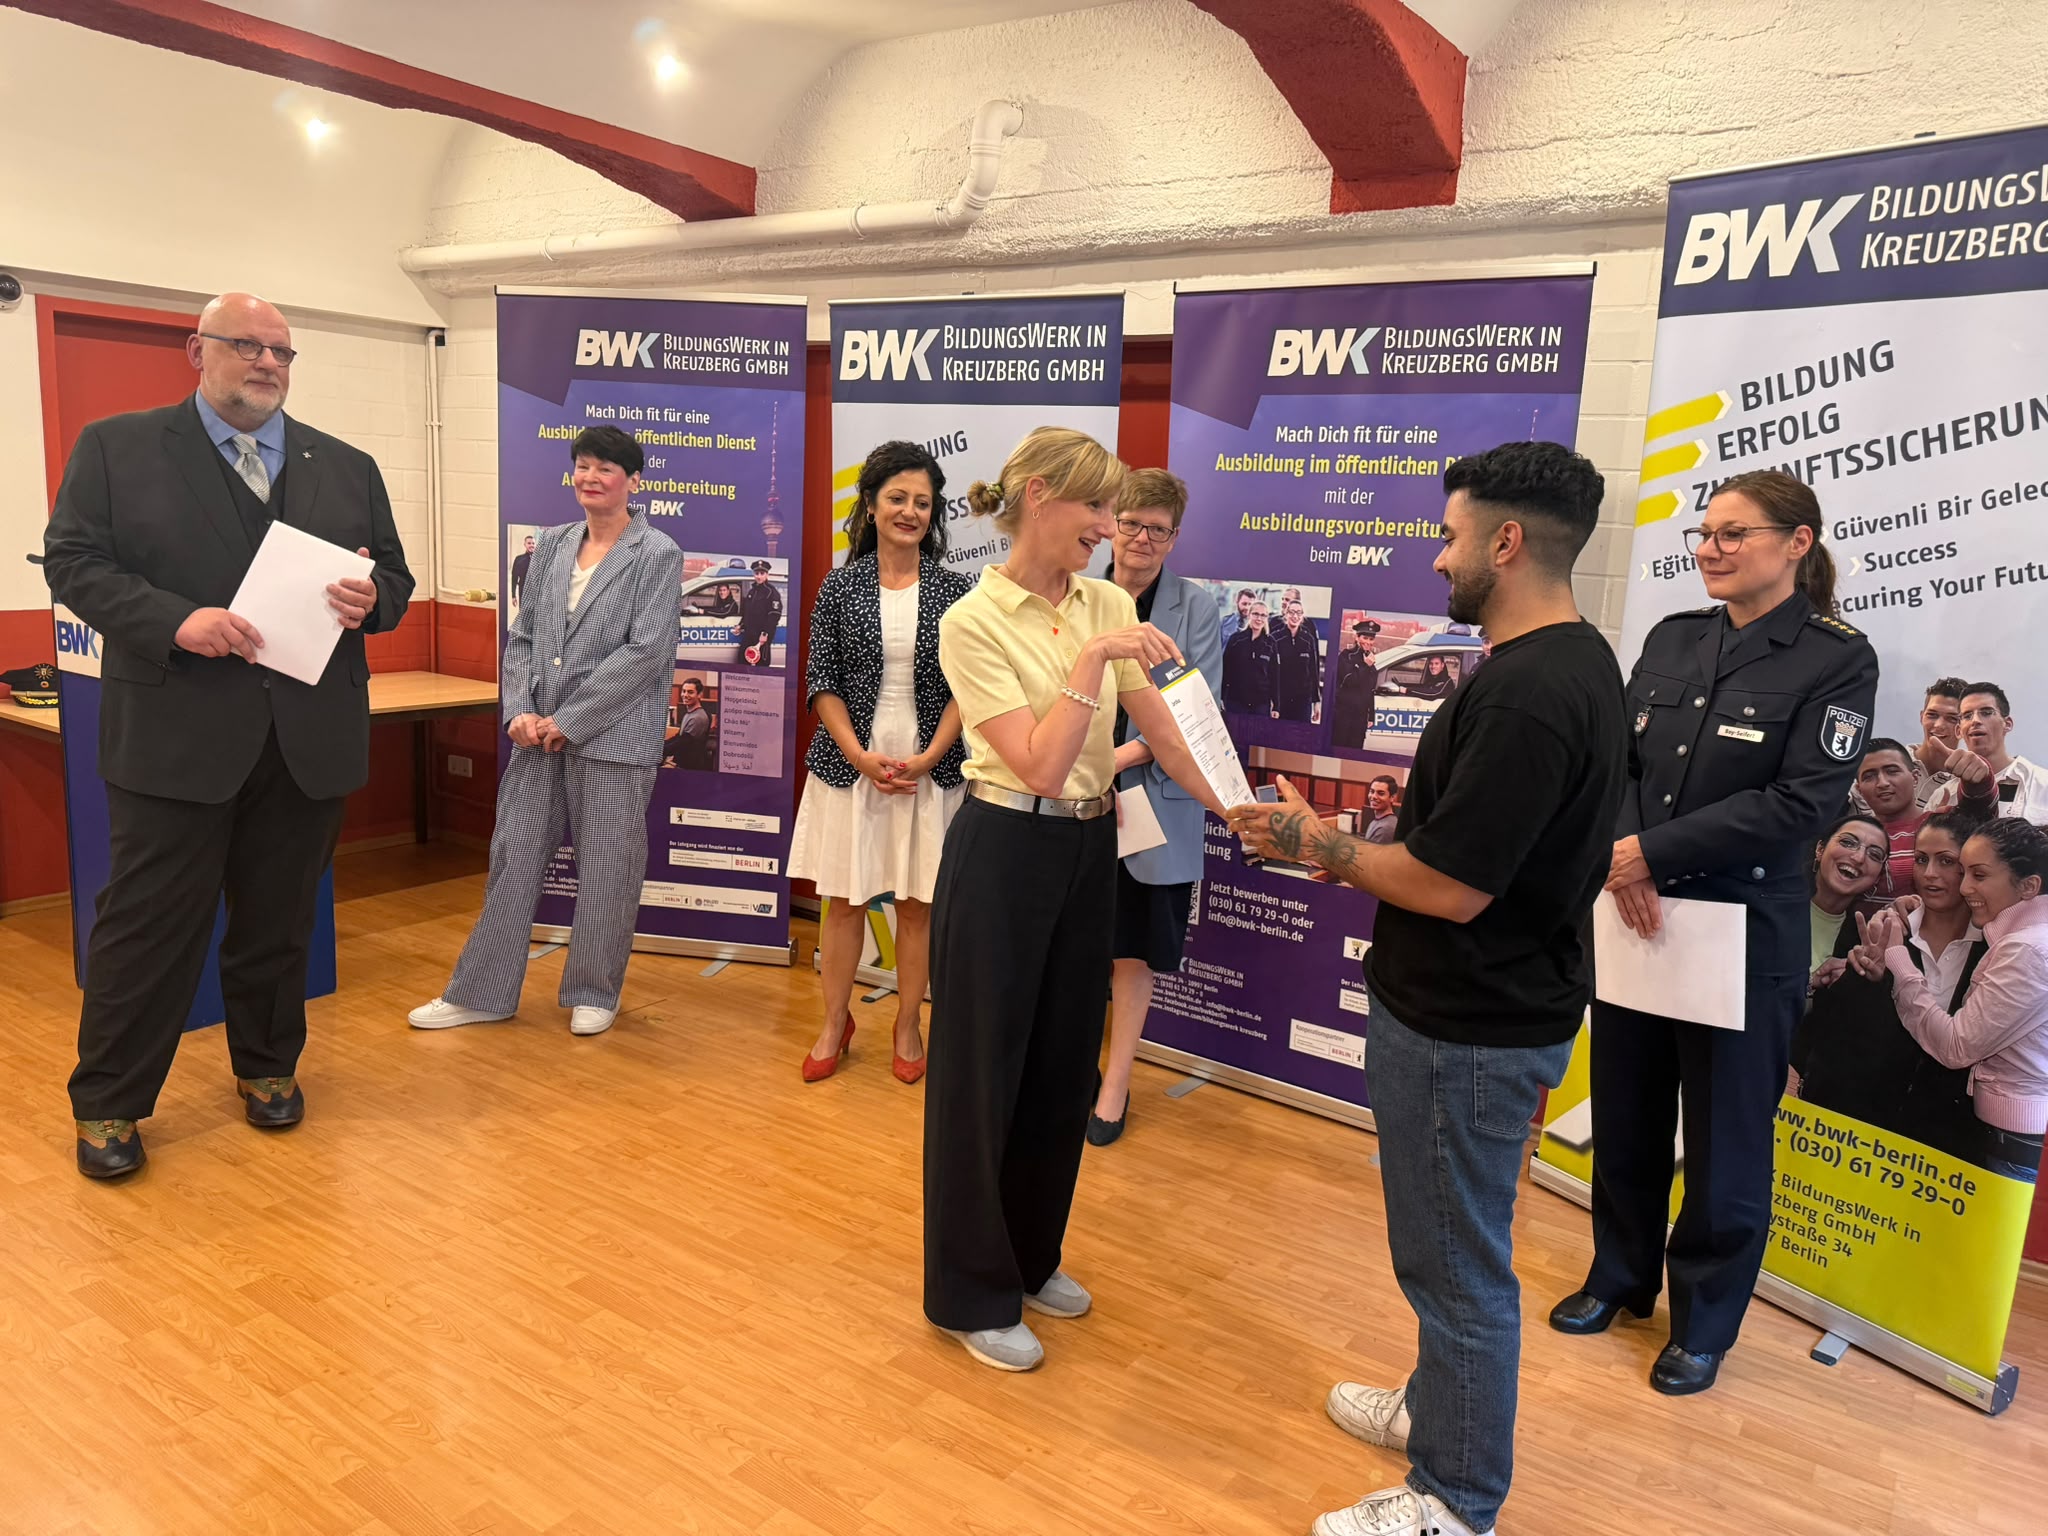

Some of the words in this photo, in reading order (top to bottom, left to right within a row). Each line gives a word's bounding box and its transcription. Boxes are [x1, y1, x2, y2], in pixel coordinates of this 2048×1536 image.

[1868, 164, 2048, 222] BILDUNGS
[1673, 193, 1865, 286] BWK
[1087, 325, 1107, 347] IN
[1540, 327, 1562, 347] IN
[575, 328, 661, 369] BWK
[774, 341, 789, 356] IN
[839, 329, 941, 381] BWK
[1267, 327, 1381, 377] BWK
[1740, 339, 1895, 411] BILDUNG
[586, 404, 615, 419] Mach
[620, 406, 643, 420] Dich
[647, 407, 660, 421] fit
[664, 409, 682, 423] für
[685, 410, 710, 424] eine
[538, 424, 585, 440] Ausbil
[634, 428, 712, 449] öffentlichen
[717, 434, 756, 451] Dienst
[1276, 426, 1313, 443] Mach
[1318, 426, 1349, 444] Dich
[1353, 426, 1371, 443] fit
[1376, 426, 1400, 444] für
[1404, 427, 1438, 444] eine
[1717, 403, 1841, 462] ERFOLG
[649, 455, 666, 468] der
[1215, 453, 1304, 477] Ausbildung
[1310, 454, 1330, 474] im
[1335, 454, 1438, 476] öffentlichen
[650, 499, 685, 517] BWK
[1325, 488, 1347, 504] mit
[1350, 488, 1374, 505] der
[1240, 512, 1444, 539] Ausbildungsvorbereitu
[1833, 503, 1928, 541] Güvenli
[1938, 495, 1972, 521] Bir
[946, 540, 996, 564] Güvenli
[1310, 546, 1342, 564] beim
[1347, 545, 1393, 566] BWK
[1863, 541, 1958, 573] Success
[1832, 586, 1923, 616] ecuring
[1930, 574, 1986, 599] Your
[56, 620, 100, 660] BWK
[681, 630, 729, 640] POLIZEI
[725, 674, 750, 682] Welcome
[725, 685, 760, 693] Willkommen
[1829, 709, 1865, 728] POLIZEI
[723, 729, 745, 737] Witamy
[723, 740, 758, 749] Bienvenidos
[735, 859, 760, 868] BERLIN
[1209, 881, 1231, 895] Jetzt
[1233, 886, 1279, 906] bewerben
[1282, 899, 1309, 912] unter
[752, 903, 773, 915] VAK
[1209, 894, 1233, 911] (030)
[1235, 903, 1246, 914] 61
[1250, 905, 1261, 917] 79
[1292, 917, 1315, 929] oder
[1208, 910, 1304, 943] info@bwk-berlin.de
[1204, 984, 1218, 993] Berlin
[1341, 978, 1351, 986] Der
[1332, 1047, 1352, 1058] BERLIN
[1774, 1106, 1977, 1196] ww.bwk-berlin.de
[1790, 1130, 1842, 1168] (030)
[1849, 1157, 1872, 1177] 61
[1880, 1167, 1905, 1188] 79
[1912, 1180, 1965, 1216] 29-0
[1781, 1173, 1898, 1233] BildungsWerk
[1904, 1223, 1921, 1243] in
[1823, 1213, 1876, 1245] GmbH
[1781, 1235, 1828, 1268] Berlin
[1832, 1238, 1853, 1257] 34
